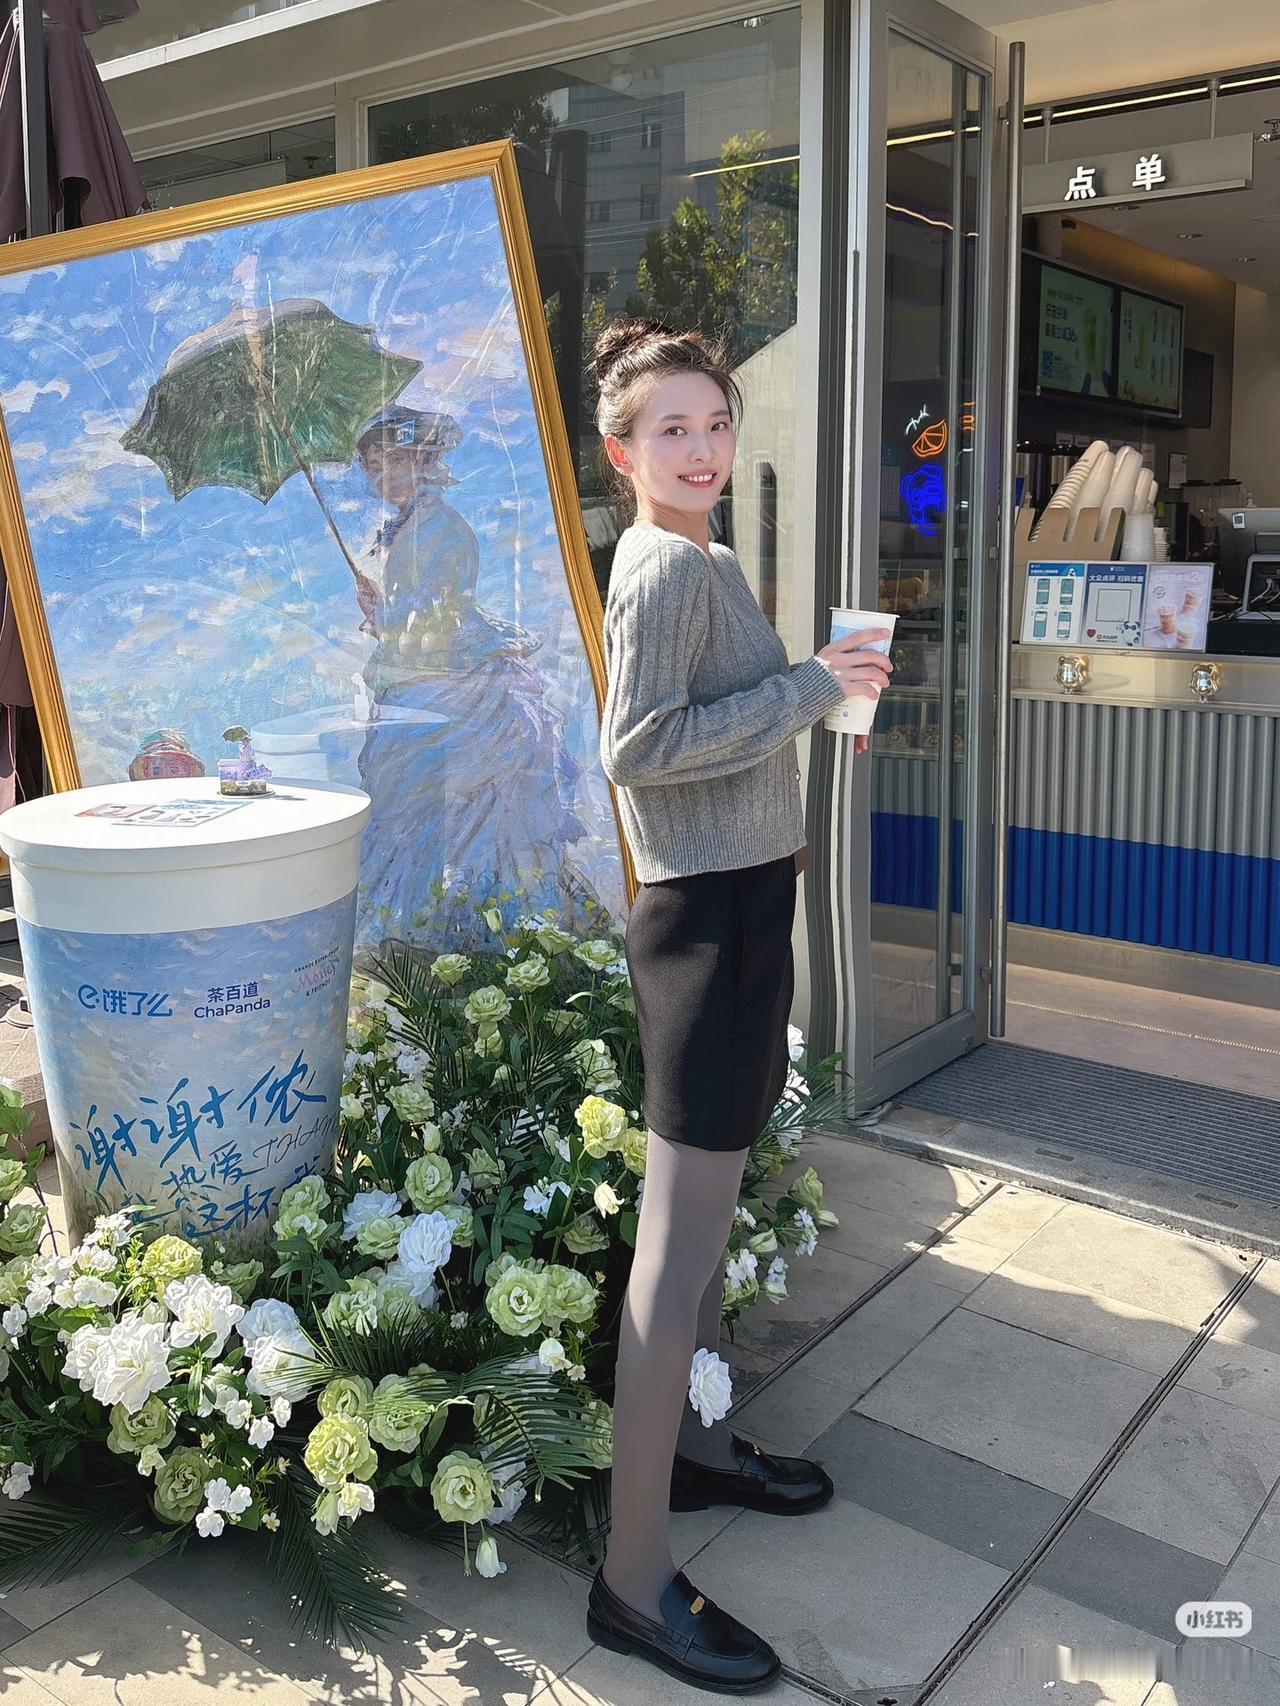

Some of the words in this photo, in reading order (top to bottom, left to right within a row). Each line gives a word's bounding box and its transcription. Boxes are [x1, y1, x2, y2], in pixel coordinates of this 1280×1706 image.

[1064, 154, 1166, 201] 点单
[194, 998, 271, 1019] ChaPanda
[207, 981, 259, 1003] 茶百道
[69, 1049, 327, 1191] 谢谢侬
[161, 1140, 266, 1202] 热爱
